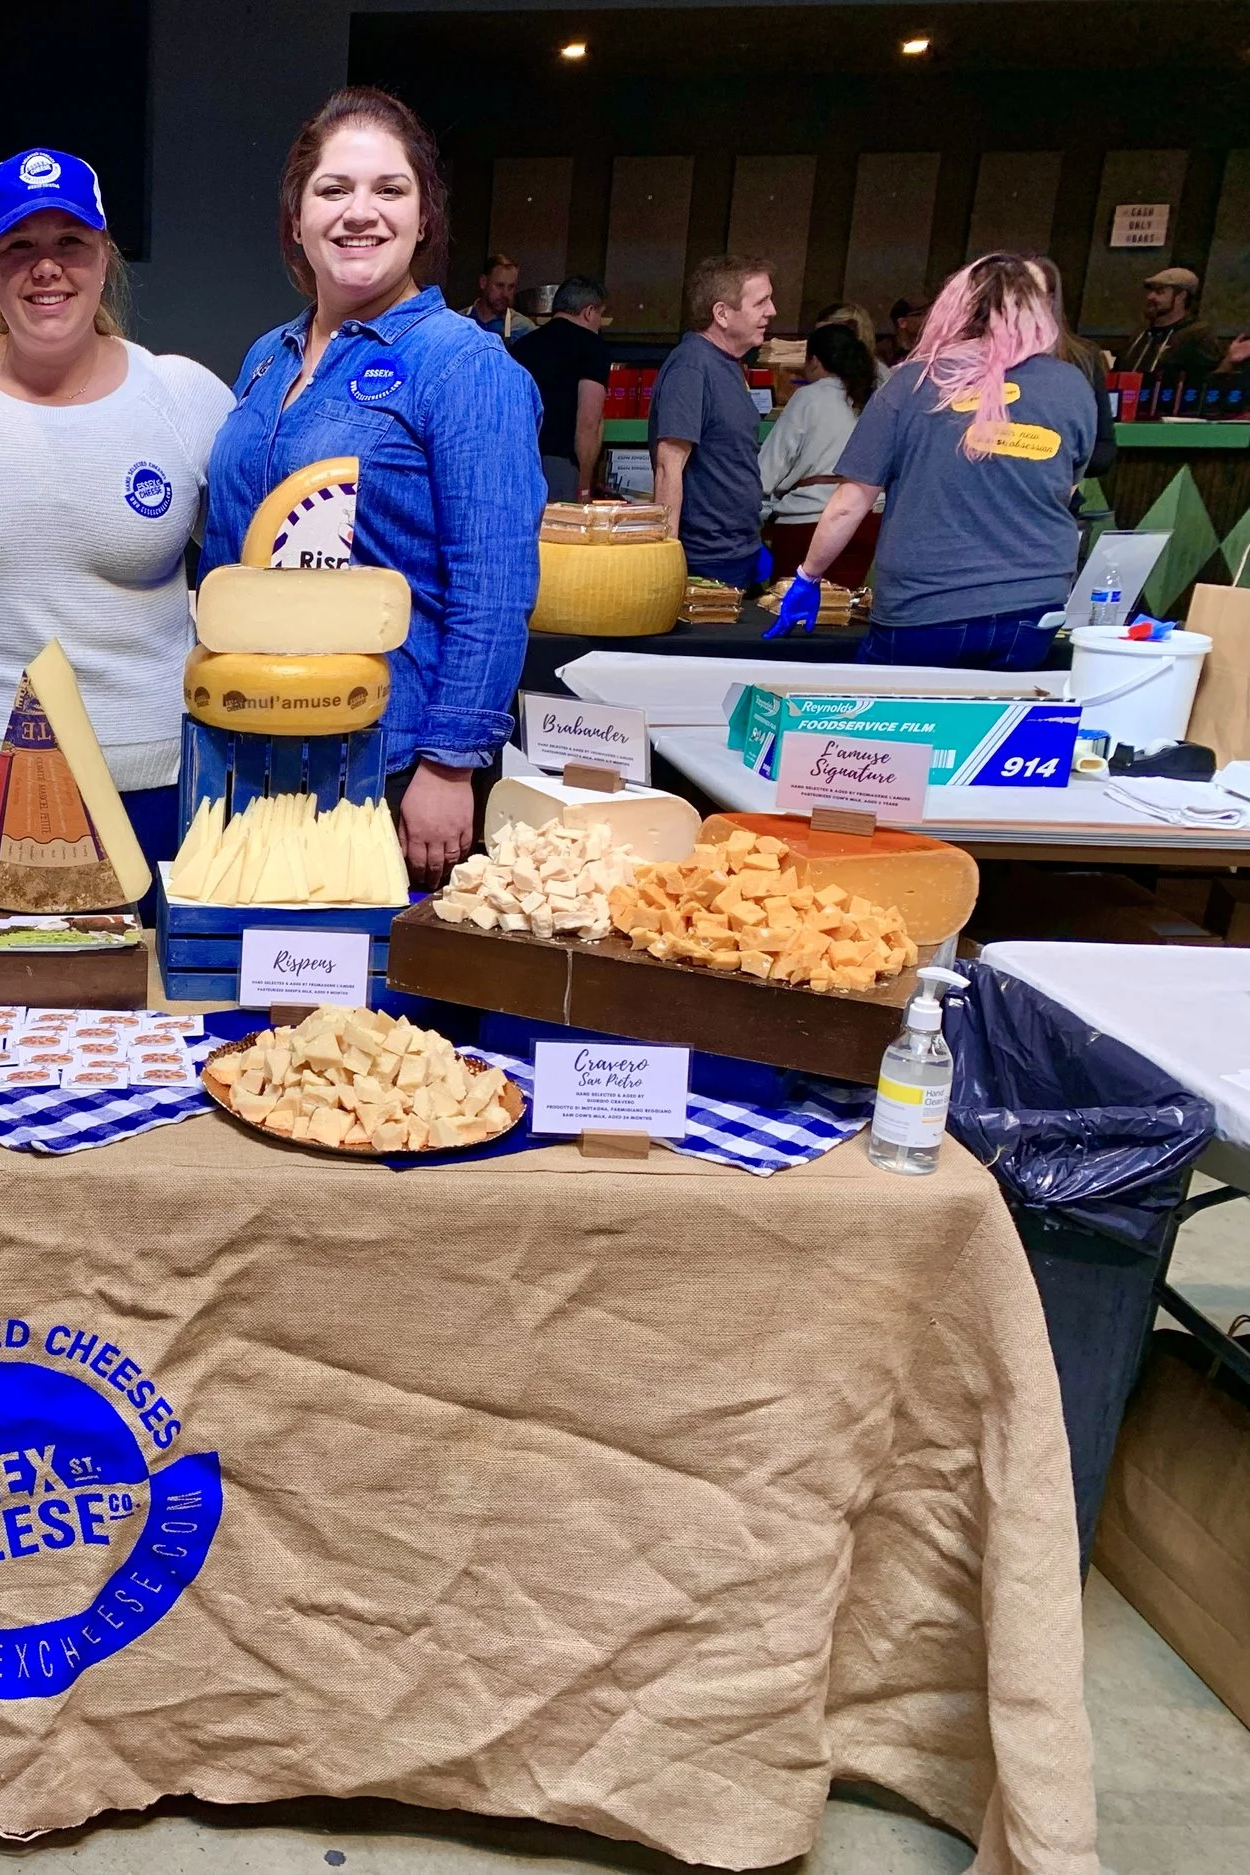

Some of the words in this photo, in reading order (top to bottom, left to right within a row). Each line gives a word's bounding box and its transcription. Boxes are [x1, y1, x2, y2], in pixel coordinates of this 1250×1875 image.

[364, 369, 389, 377] ESSEX
[801, 701, 854, 714] Reynolds
[543, 713, 629, 744] Brabander
[798, 720, 898, 732] FOODSERVICE
[900, 722, 935, 733] FILM
[821, 740, 891, 766] L'amuse
[810, 758, 897, 784] Signature
[1001, 757, 1061, 778] 914
[273, 950, 336, 977] Rispens
[574, 1048, 650, 1073] Cravero
[578, 1071, 601, 1087] San
[606, 1073, 643, 1089] Pietro
[45, 1325, 181, 1449] CHEESES
[69, 1456, 102, 1476] ST.
[108, 1492, 142, 1514] CO.
